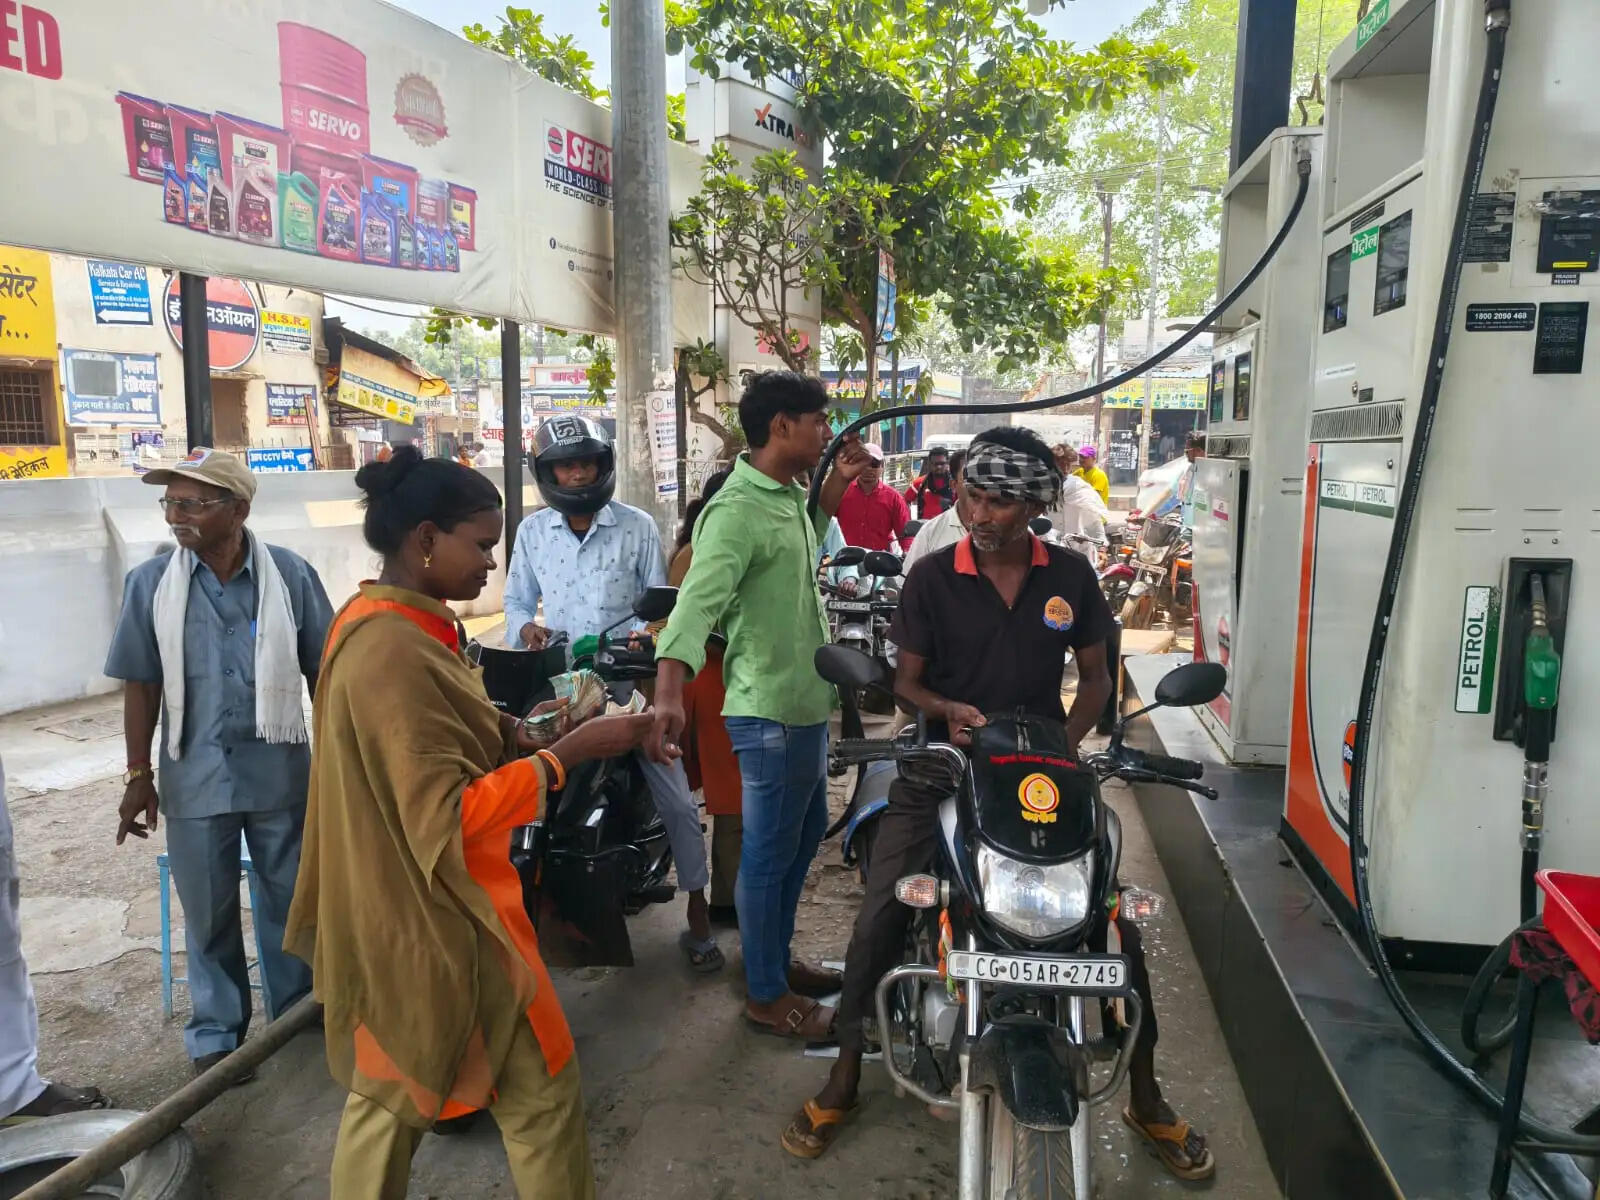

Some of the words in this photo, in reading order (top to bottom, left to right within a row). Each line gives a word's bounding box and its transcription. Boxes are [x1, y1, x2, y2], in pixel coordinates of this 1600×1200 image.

[308, 109, 361, 140] SERVO
[547, 162, 598, 193] WORLD-CLASS
[545, 179, 561, 193] THE
[562, 186, 595, 205] SCIENCE
[1352, 233, 1378, 257] पेट्रोल
[118, 265, 132, 279] Car
[134, 267, 146, 280] AC
[267, 312, 306, 327] H.S.R.
[263, 453, 280, 461] CCTV
[1326, 483, 1348, 498] PETROL
[1362, 486, 1387, 504] PETROL
[1461, 612, 1484, 689] PETROL
[976, 957, 999, 982] CG
[1009, 961, 1059, 984] 05AR
[1070, 964, 1117, 985] 2749
